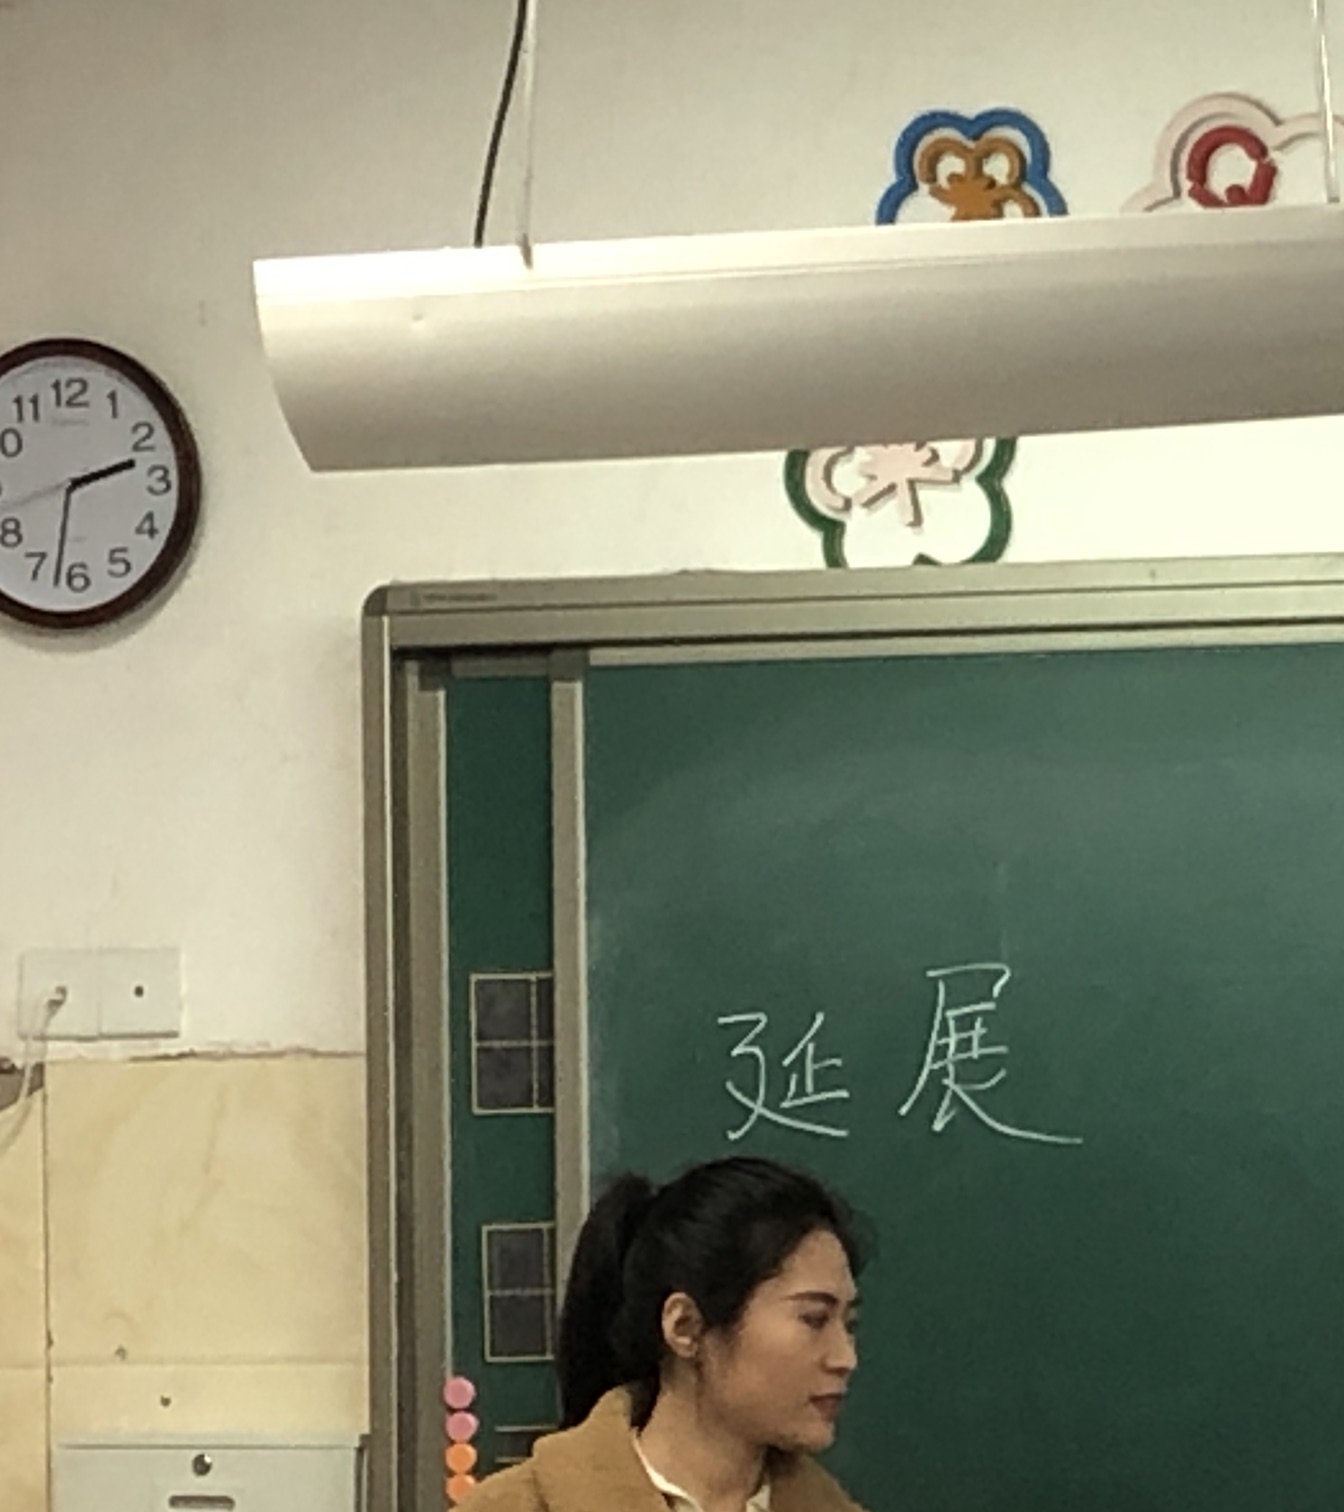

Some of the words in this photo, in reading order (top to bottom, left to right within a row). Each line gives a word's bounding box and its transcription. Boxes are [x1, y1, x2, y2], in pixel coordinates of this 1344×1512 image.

[13, 393, 40, 423] 11
[51, 377, 89, 408] 12
[106, 389, 119, 420] 1
[131, 422, 155, 452] 2
[146, 465, 172, 496] 3
[0, 517, 23, 548] 8
[135, 510, 159, 540] 4
[25, 552, 48, 582] 7
[66, 562, 91, 593] 6
[107, 547, 132, 578] 5
[718, 962, 1083, 1145] 延展
